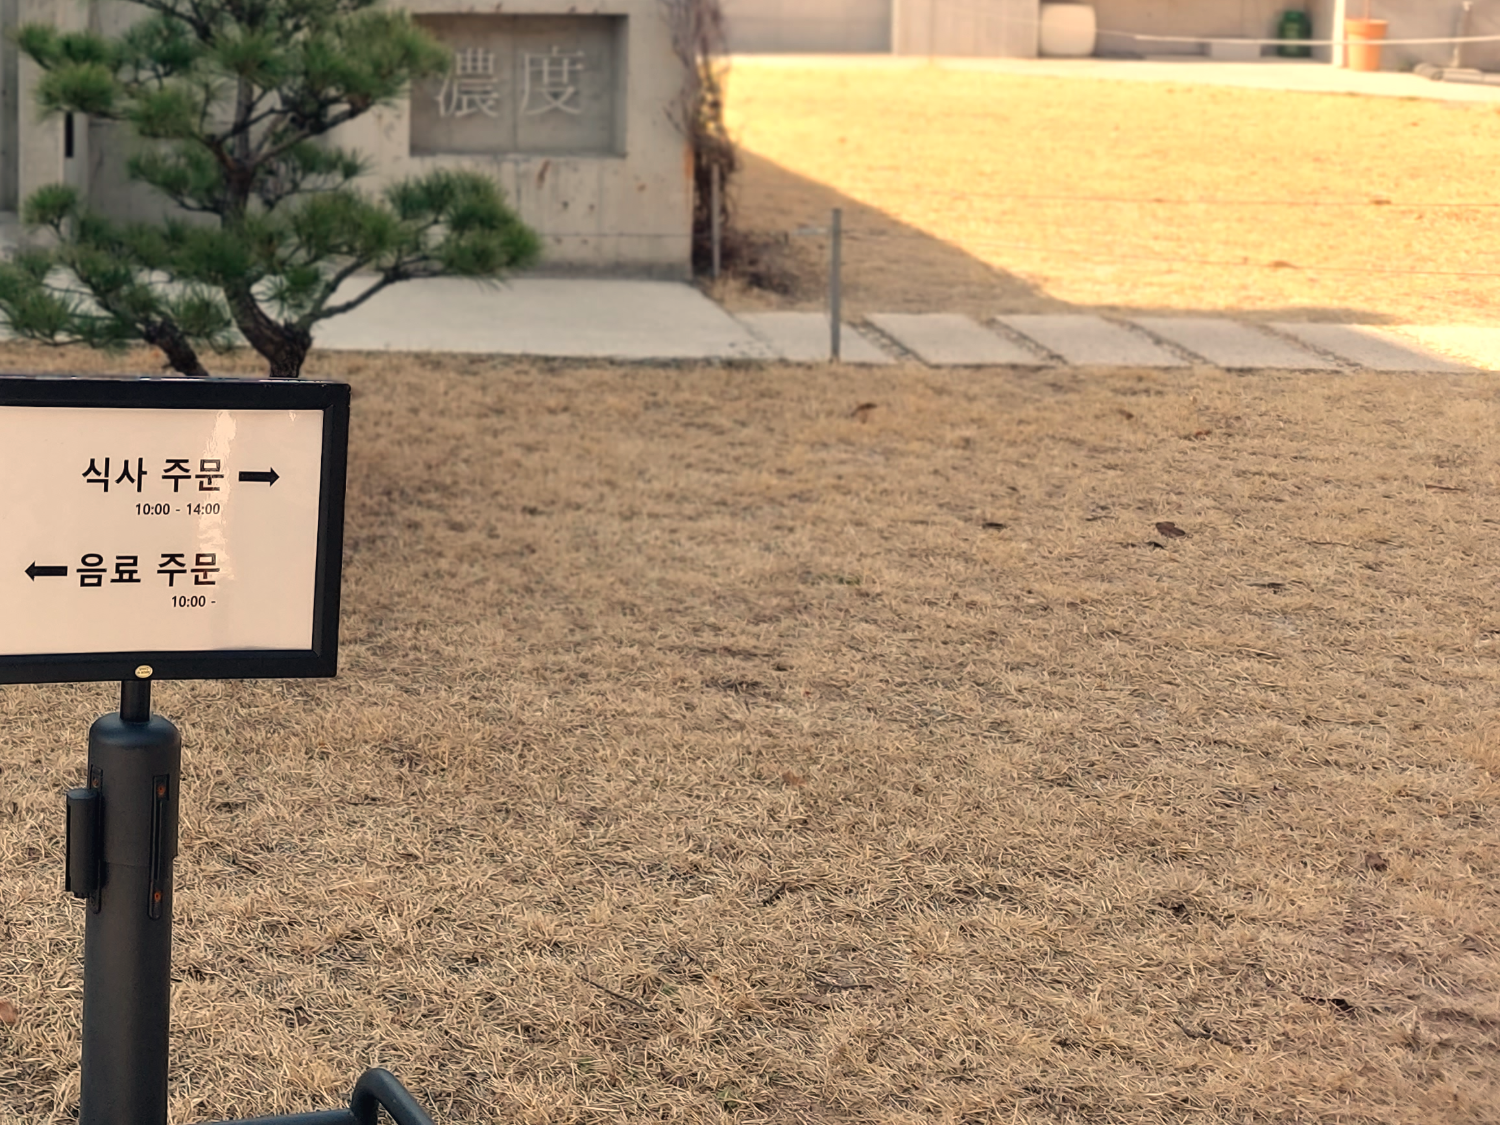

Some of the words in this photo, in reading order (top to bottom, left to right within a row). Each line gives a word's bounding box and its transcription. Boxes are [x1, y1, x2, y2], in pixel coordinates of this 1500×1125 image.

[81, 456, 148, 493] 식사
[161, 458, 225, 493] 주문
[135, 502, 171, 516] 10:00
[186, 502, 221, 516] 14:00
[75, 552, 142, 588] 음료
[156, 552, 221, 588] 주문
[171, 595, 206, 608] 10:00
